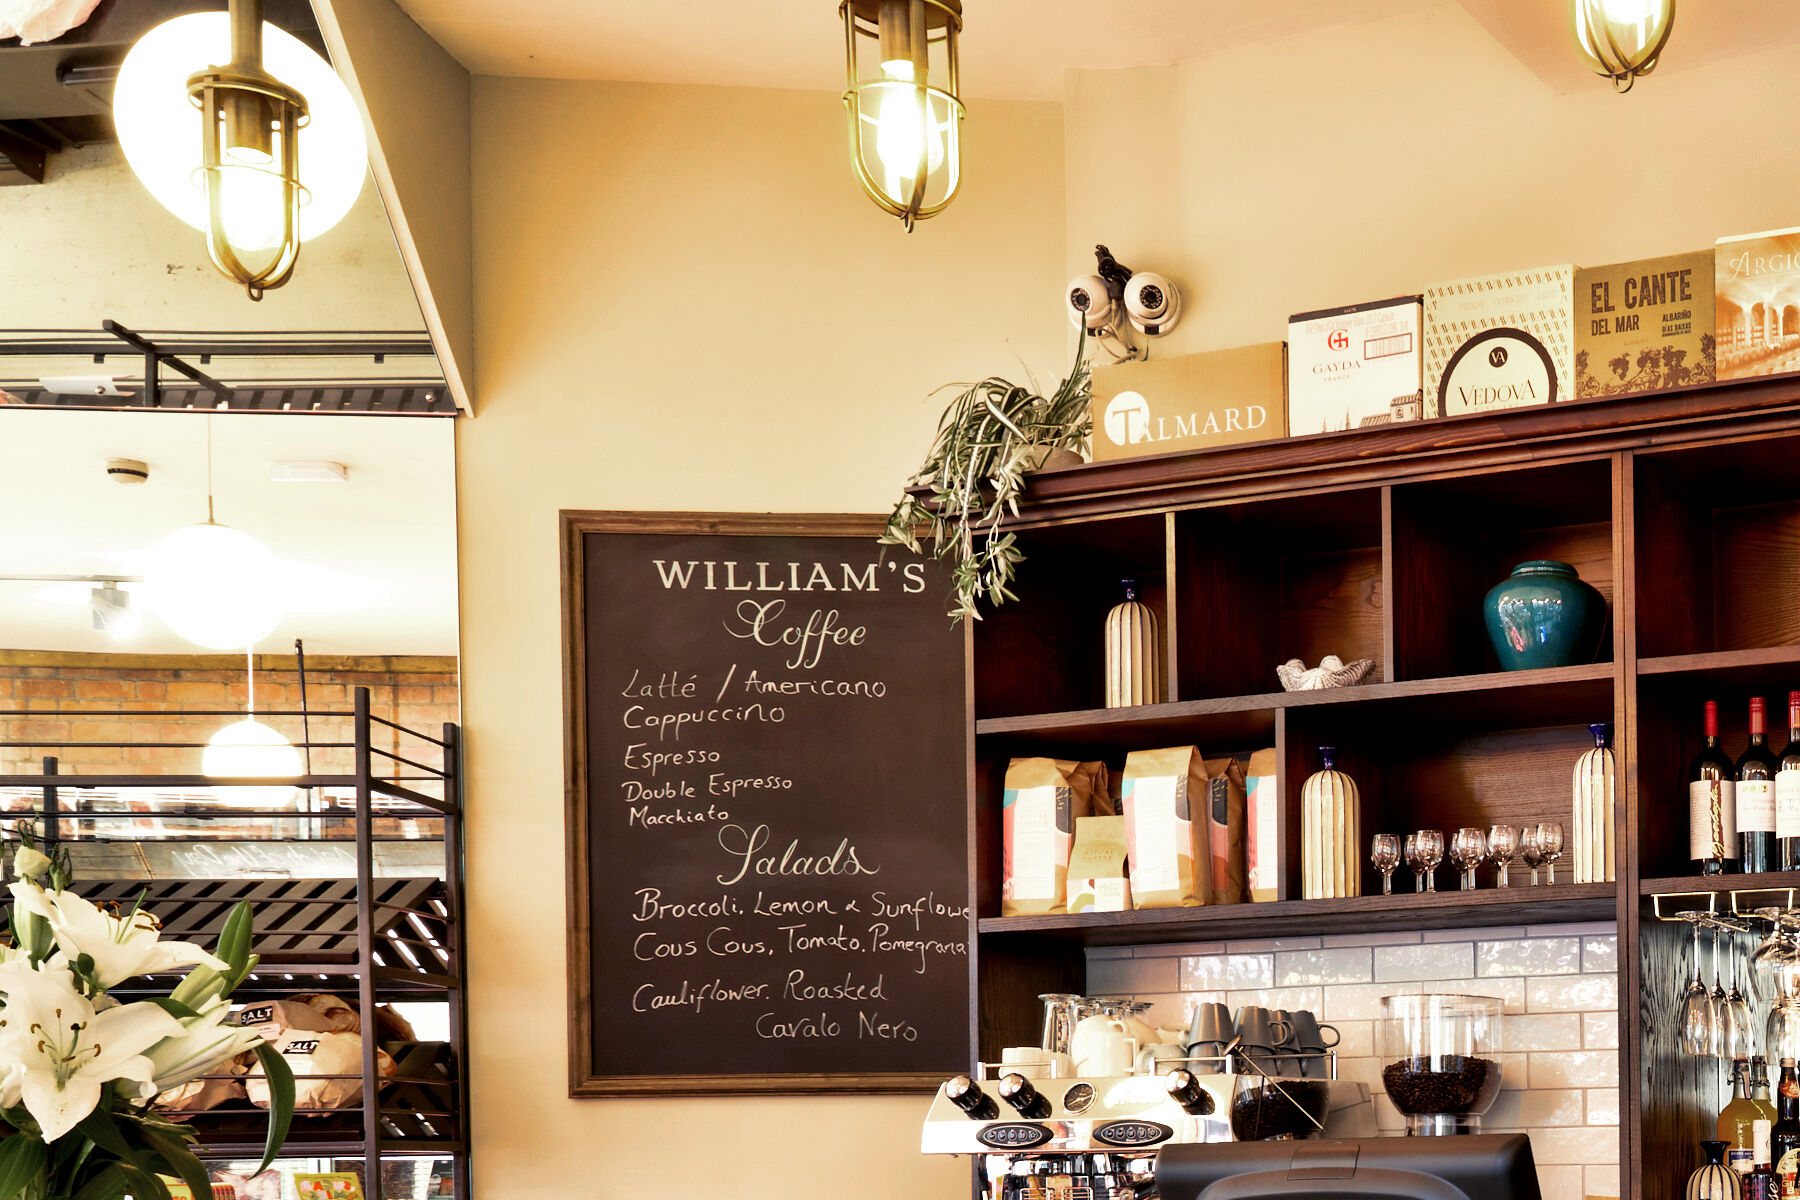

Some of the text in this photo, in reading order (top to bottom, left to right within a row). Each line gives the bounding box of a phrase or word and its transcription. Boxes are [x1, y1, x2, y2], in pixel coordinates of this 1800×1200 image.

[1591, 281, 1615, 314] EL
[1625, 269, 1692, 309] CANTE
[1591, 314, 1640, 336] DEL MAR
[1662, 310, 1691, 322] ALBARIÑO
[1313, 360, 1361, 374] GAYDA
[1459, 378, 1536, 407] VEDOVA
[1111, 404, 1267, 446] TALMARD
[653, 560, 927, 594] WILLIAM'S
[722, 599, 867, 669] Coffee
[622, 669, 697, 698] Latté
[745, 670, 887, 697] Americano
[623, 703, 785, 741] Cappuccino
[624, 743, 720, 776] Espresso
[621, 773, 793, 802] Double Espresso
[629, 804, 730, 829] Macchiato
[716, 824, 881, 885] Salads
[753, 891, 838, 917] Lemon
[871, 891, 970, 931] Sunflowe
[633, 932, 697, 961] Cous
[868, 922, 970, 974] Pomegrana
[783, 969, 889, 1002] Roasted
[242, 1008, 273, 1023] SALT
[755, 1012, 918, 1041] Cavalo Nero
[287, 1041, 319, 1050] SALT
